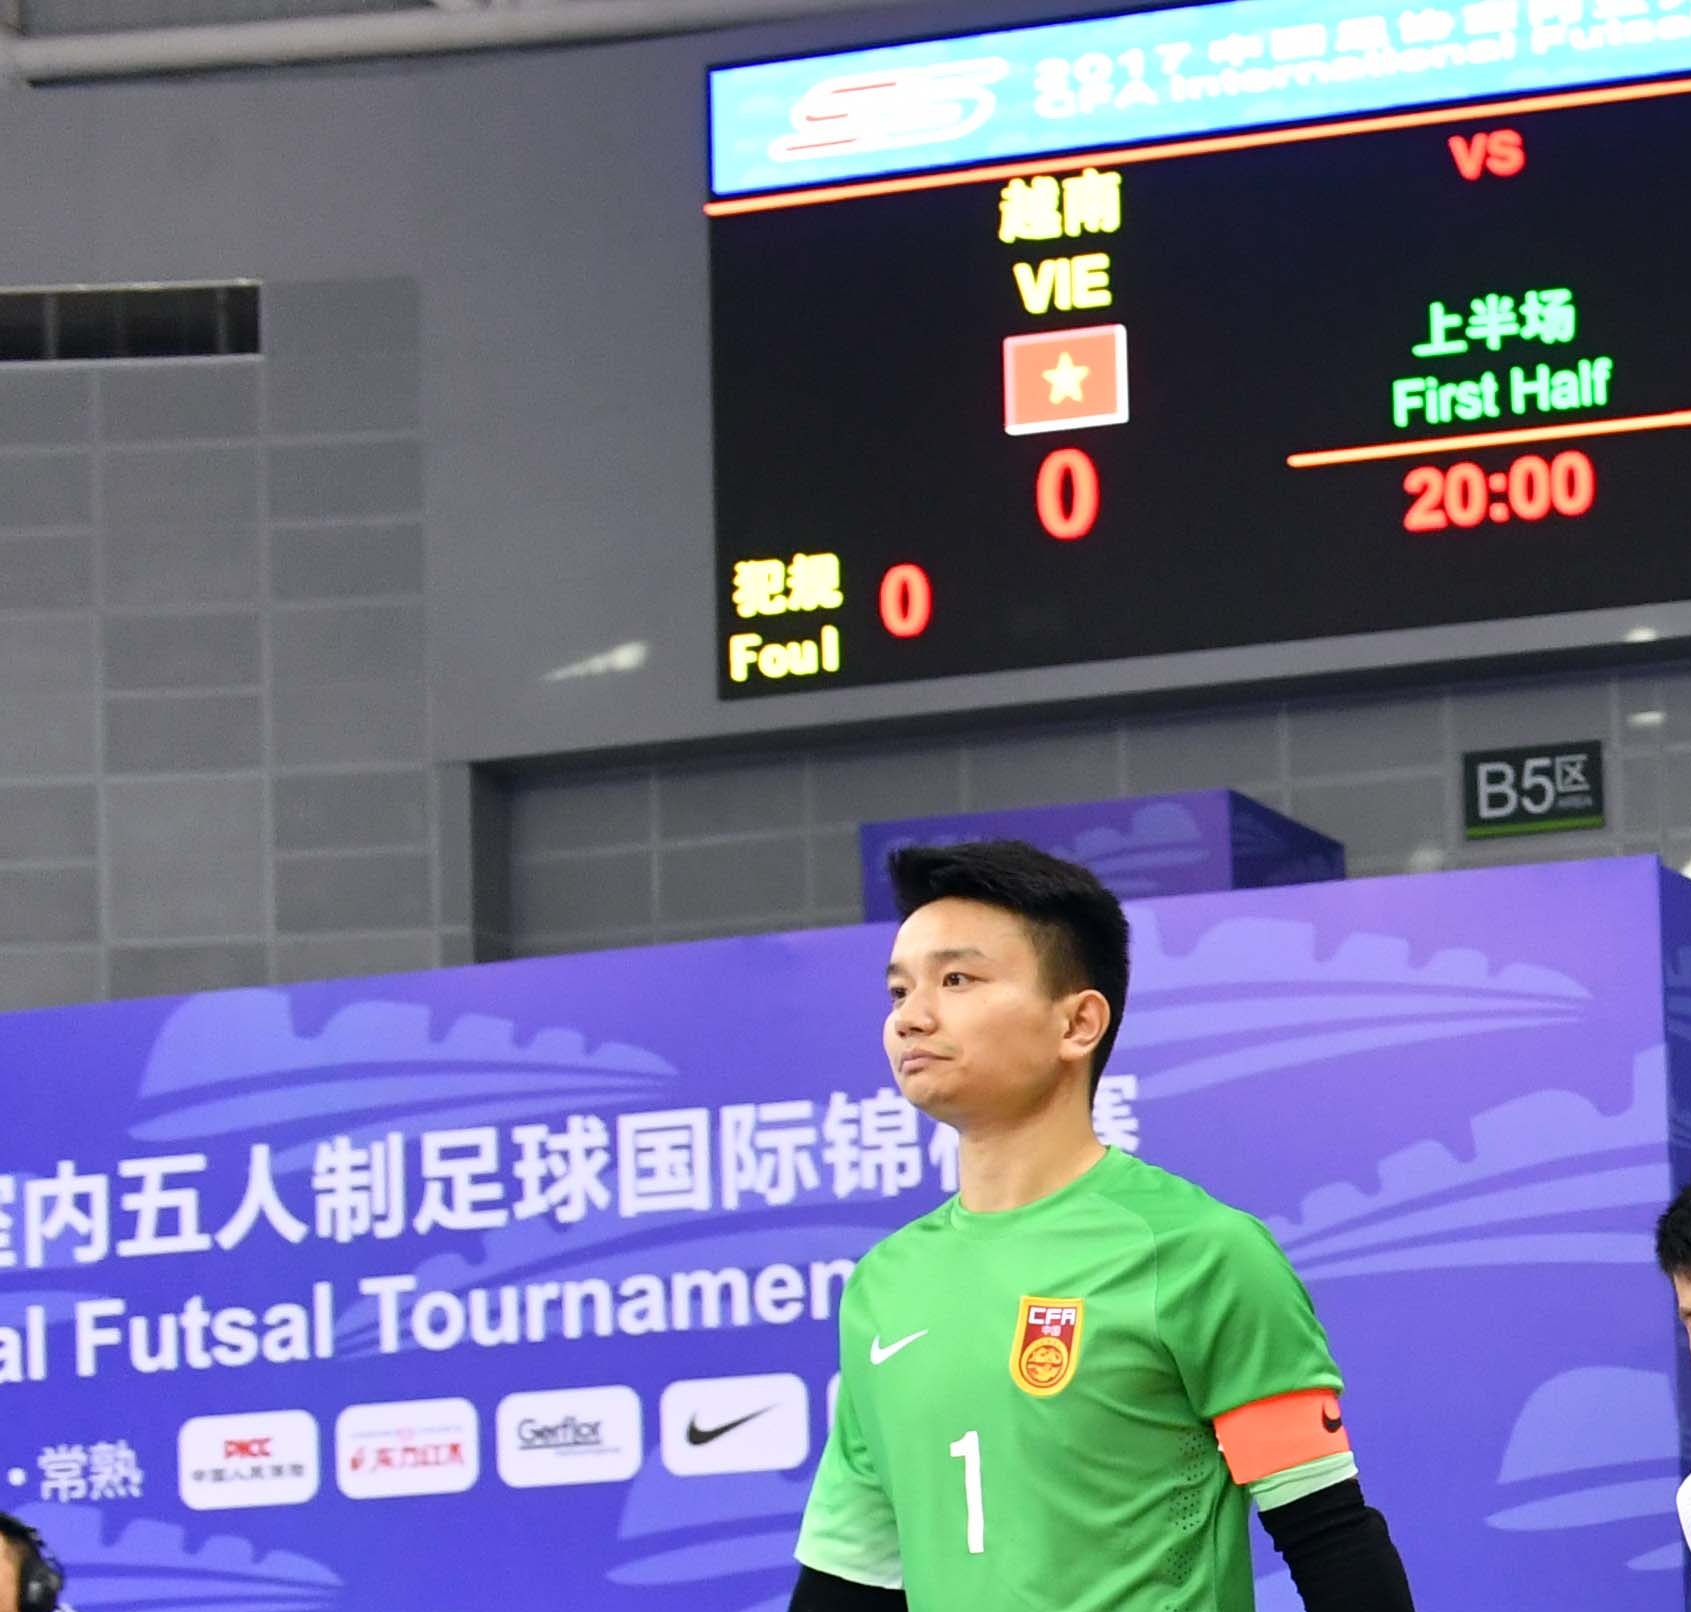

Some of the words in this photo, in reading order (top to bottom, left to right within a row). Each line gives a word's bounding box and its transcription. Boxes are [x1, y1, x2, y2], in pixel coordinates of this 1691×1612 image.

[1448, 129, 1525, 181] VS
[999, 168, 1122, 243] 越南
[1013, 253, 1112, 314] VIE
[1412, 289, 1576, 357] 上半场
[1393, 371, 1500, 427] First
[1509, 356, 1613, 414] Half
[1036, 448, 1101, 541] 0
[1403, 450, 1595, 532] 20:00
[880, 562, 932, 639] 0
[729, 624, 840, 683] Foul
[75, 1283, 334, 1377] Futsal
[361, 1255, 856, 1354] Tournamen
[1028, 1306, 1077, 1326] CFA
[949, 1430, 985, 1554] 1
